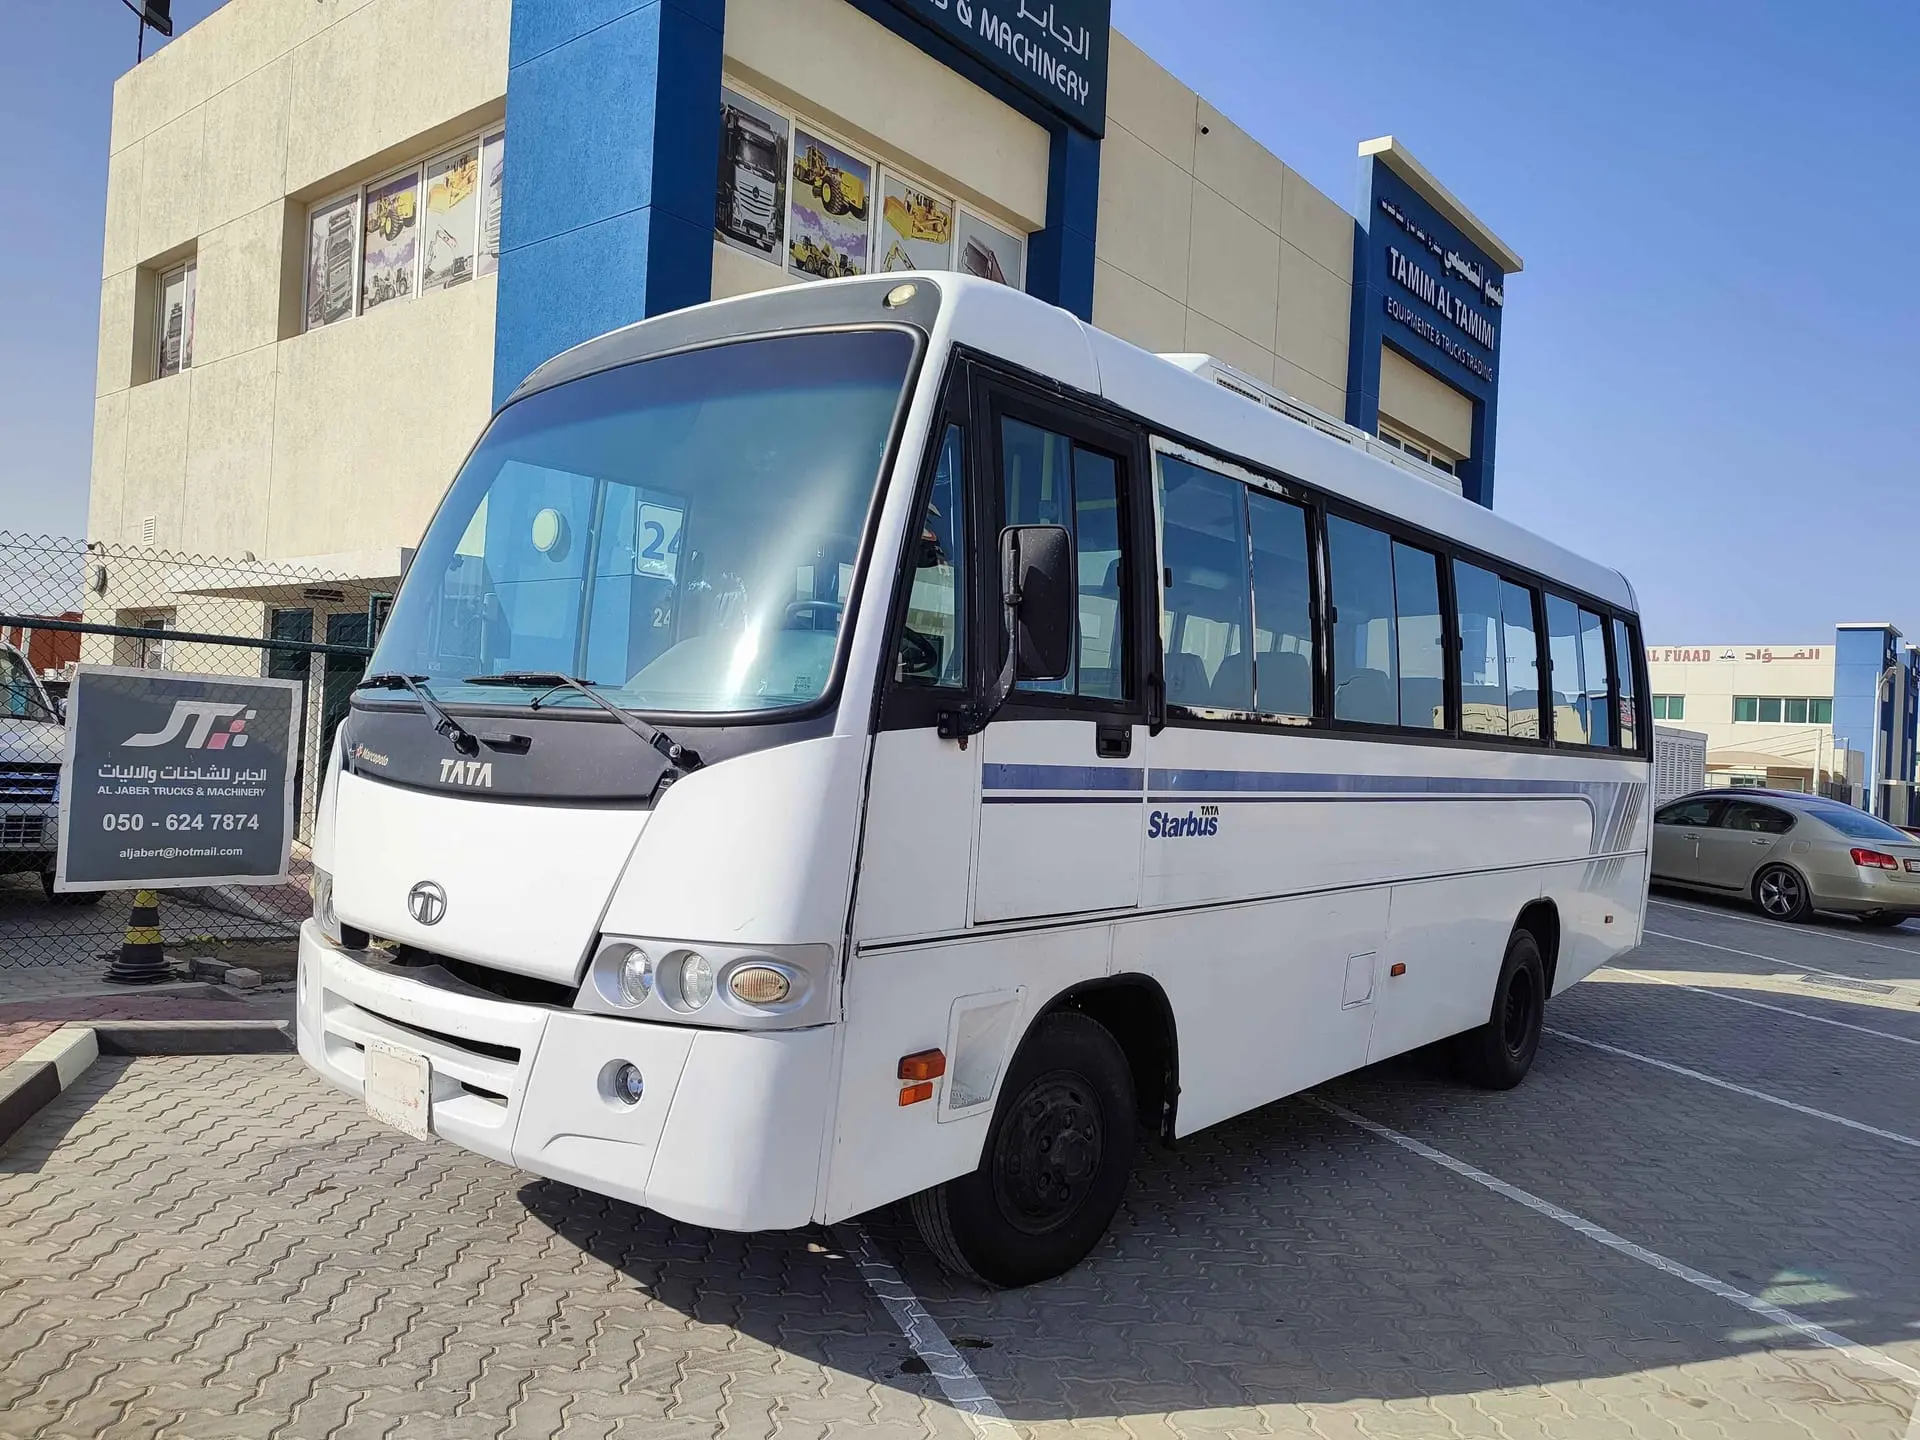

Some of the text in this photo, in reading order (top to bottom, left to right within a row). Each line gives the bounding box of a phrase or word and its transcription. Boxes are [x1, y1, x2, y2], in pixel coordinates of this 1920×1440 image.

[957, 0, 1089, 105] & MACHINERY
[1390, 246, 1495, 351] TAMIM AL TAMIMI
[1435, 330, 1441, 346] &
[1441, 334, 1465, 364] TRUCKS
[1466, 352, 1493, 382] TRADING
[1664, 649, 1711, 662] FUAAD
[98, 764, 267, 785] الجابر للشاحنات والاليات
[439, 758, 492, 788] TATA
[98, 786, 266, 797] AL JABER TRUCKS & MACHINERY
[1200, 805, 1219, 816] TATA
[102, 813, 144, 831] 050
[165, 813, 204, 831] 624
[210, 813, 260, 831] 7874
[1148, 810, 1218, 838] Starbus
[119, 846, 243, 859] aljabert@hotmail.com
